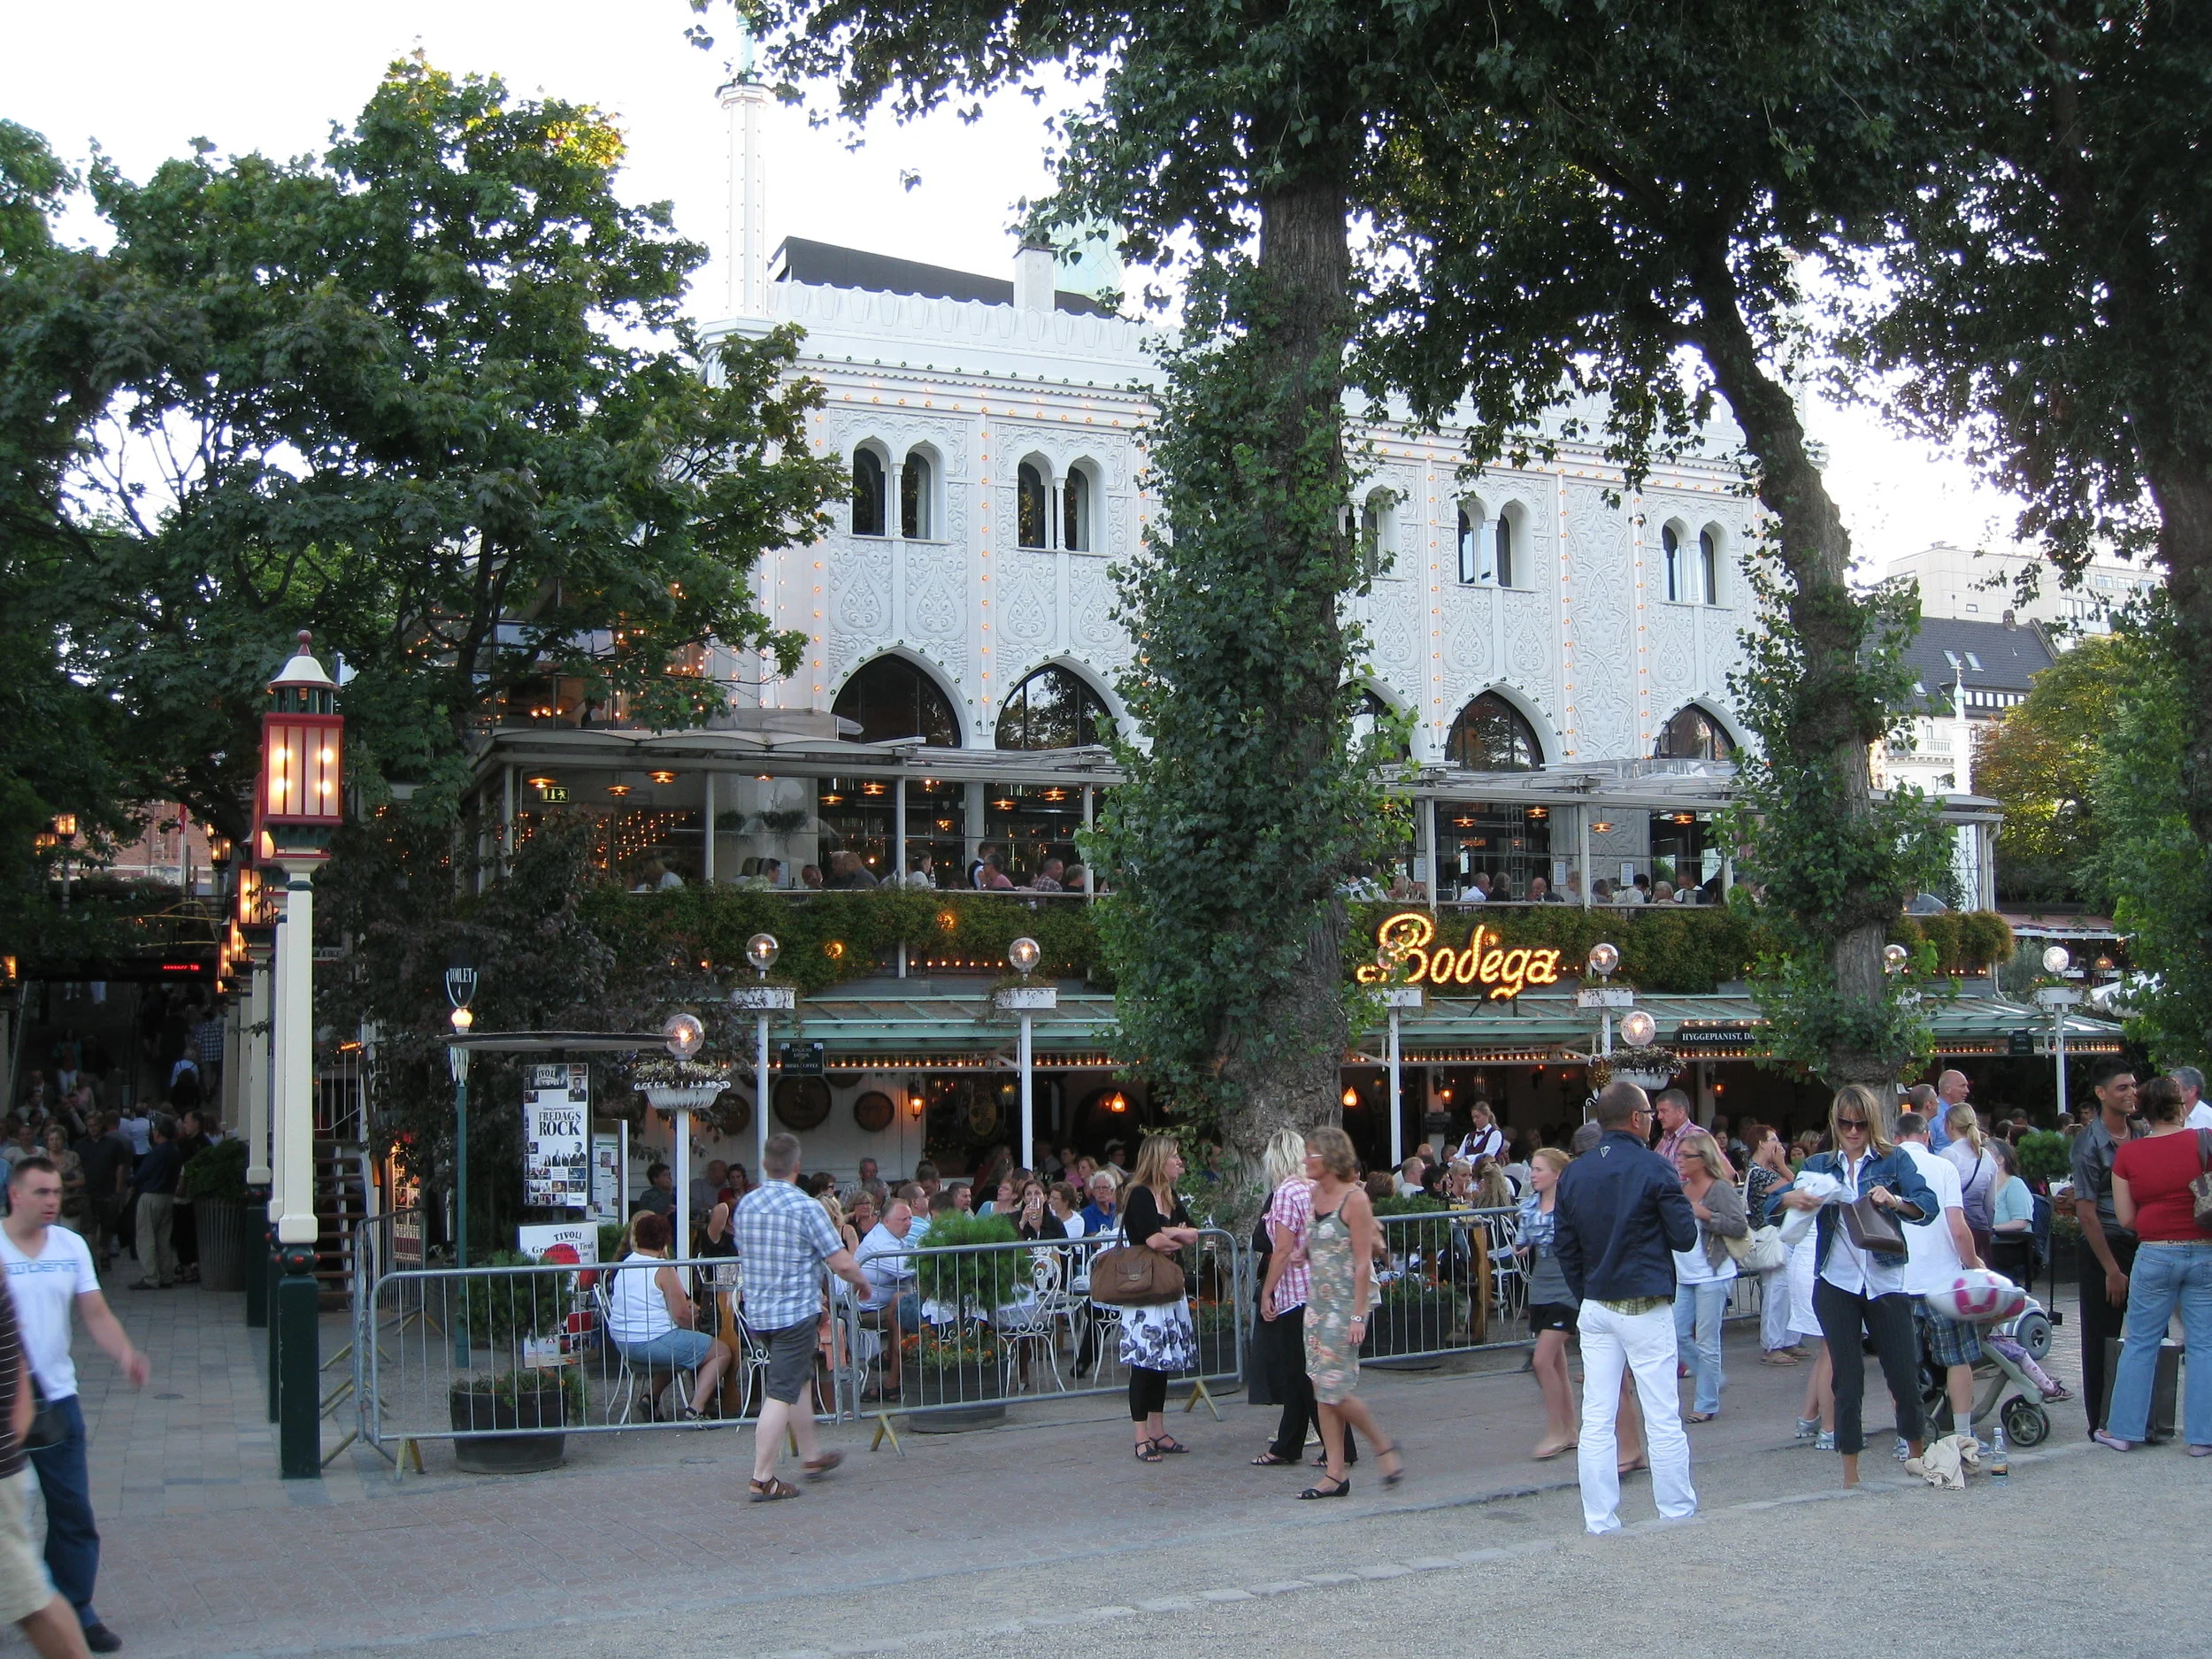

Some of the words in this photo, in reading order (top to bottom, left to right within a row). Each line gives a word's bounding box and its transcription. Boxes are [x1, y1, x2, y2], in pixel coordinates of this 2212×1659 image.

[1356, 912, 1561, 999] Bodega
[449, 968, 472, 982] TOILET
[539, 1111, 581, 1121] FREDAGS
[539, 1121, 581, 1137] ROCK
[554, 1231, 582, 1241] TIVOLI
